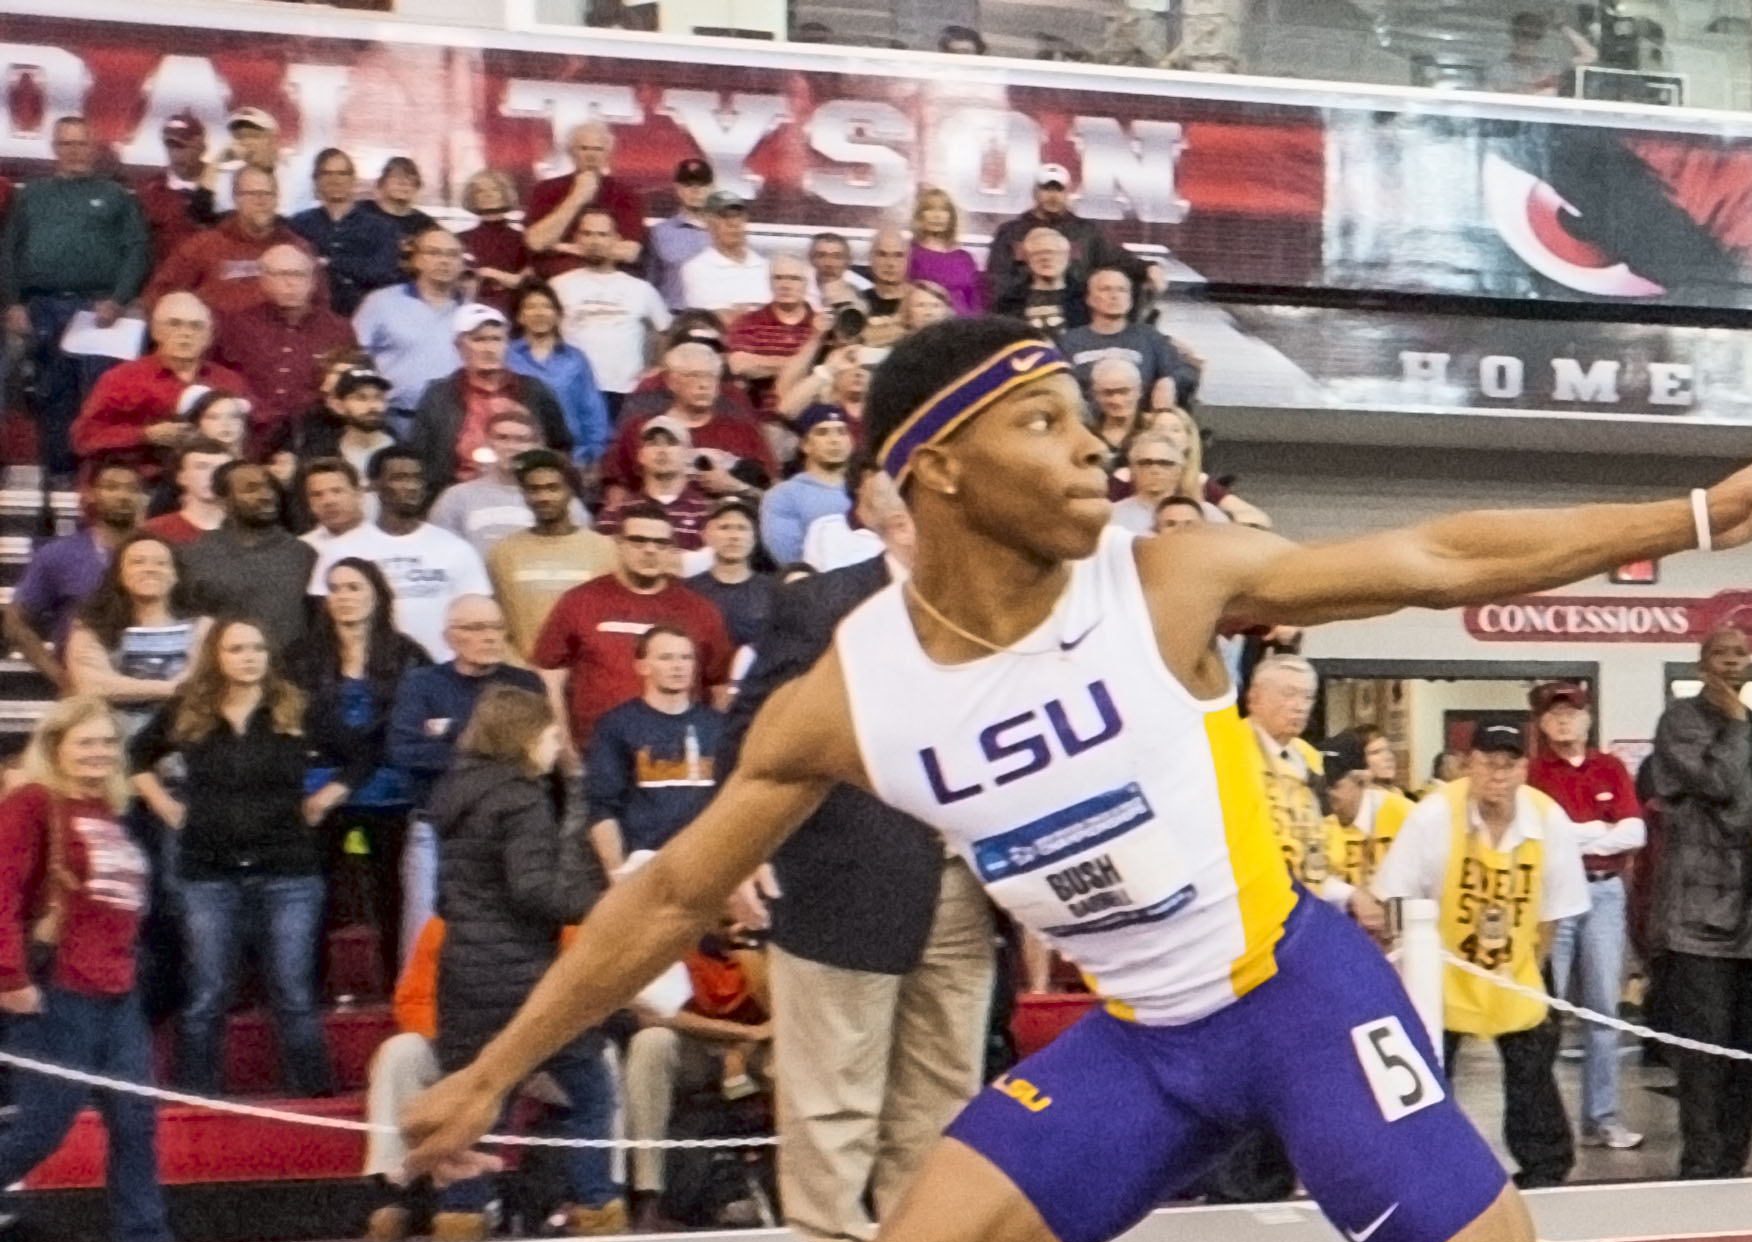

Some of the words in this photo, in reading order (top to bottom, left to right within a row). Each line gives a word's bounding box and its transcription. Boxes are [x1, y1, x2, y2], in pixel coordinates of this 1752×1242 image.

[500, 78, 1192, 225] TYSON
[1398, 350, 1694, 407] HOME
[1477, 603, 1690, 635] CONCESSIONS
[918, 679, 1124, 805] LSU
[1046, 853, 1124, 902] BUSH
[992, 1073, 1053, 1112] LSU
[1367, 1025, 1425, 1108] 5
